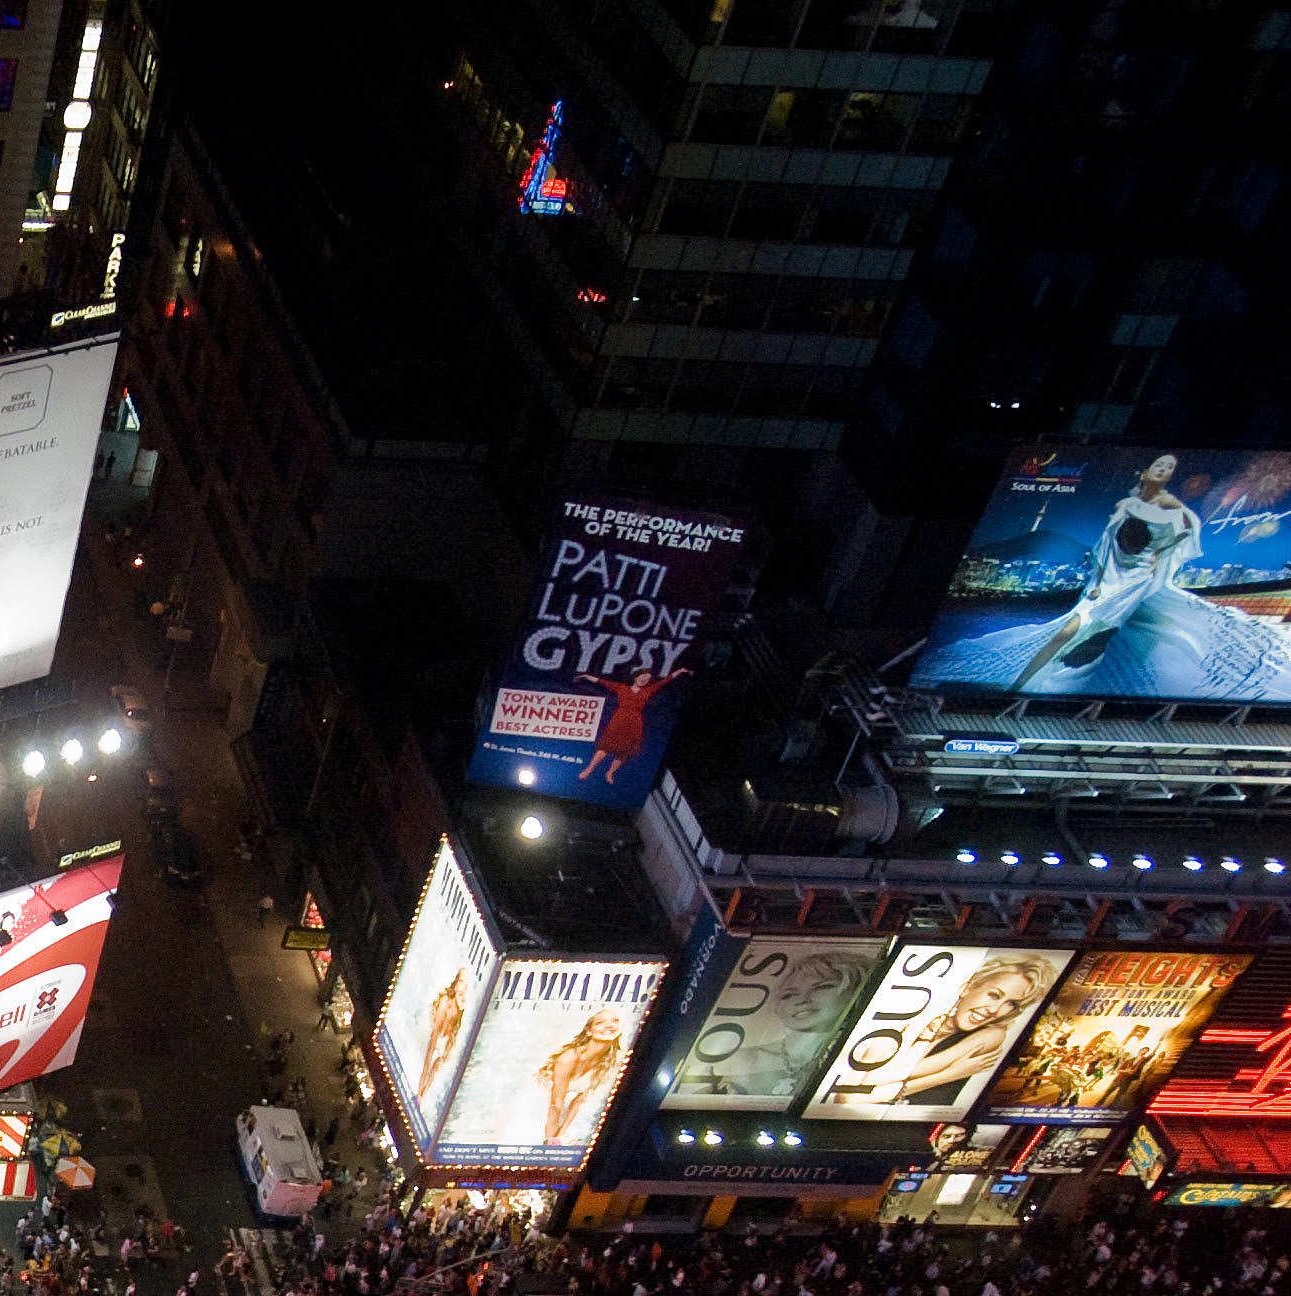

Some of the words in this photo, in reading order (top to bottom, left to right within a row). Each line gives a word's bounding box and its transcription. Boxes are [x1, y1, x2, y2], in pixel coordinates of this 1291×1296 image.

[564, 502, 600, 521] THE
[603, 509, 746, 543] PERFORMANCE
[584, 522, 614, 537] OF
[615, 524, 653, 544] THE
[655, 532, 712, 553] YEAR!
[552, 540, 668, 597] PATTI
[538, 582, 702, 641] LUPONE
[523, 626, 689, 678] GYPSY
[501, 703, 597, 725] WINNER!
[503, 691, 545, 705] TONY
[547, 695, 599, 710] AWARD
[495, 721, 530, 732] BEST
[532, 722, 593, 738] ACTRESS
[500, 970, 592, 1001] MAMMA
[602, 972, 658, 1003] MIA!
[1082, 951, 1243, 988] HEIGHTS
[677, 951, 787, 1097] TOUS
[1075, 999, 1120, 1017] BEST
[1119, 999, 1189, 1018] MUSICAL
[822, 950, 954, 1104] TOUS
[683, 1163, 838, 1180] OPPORTUNITY
